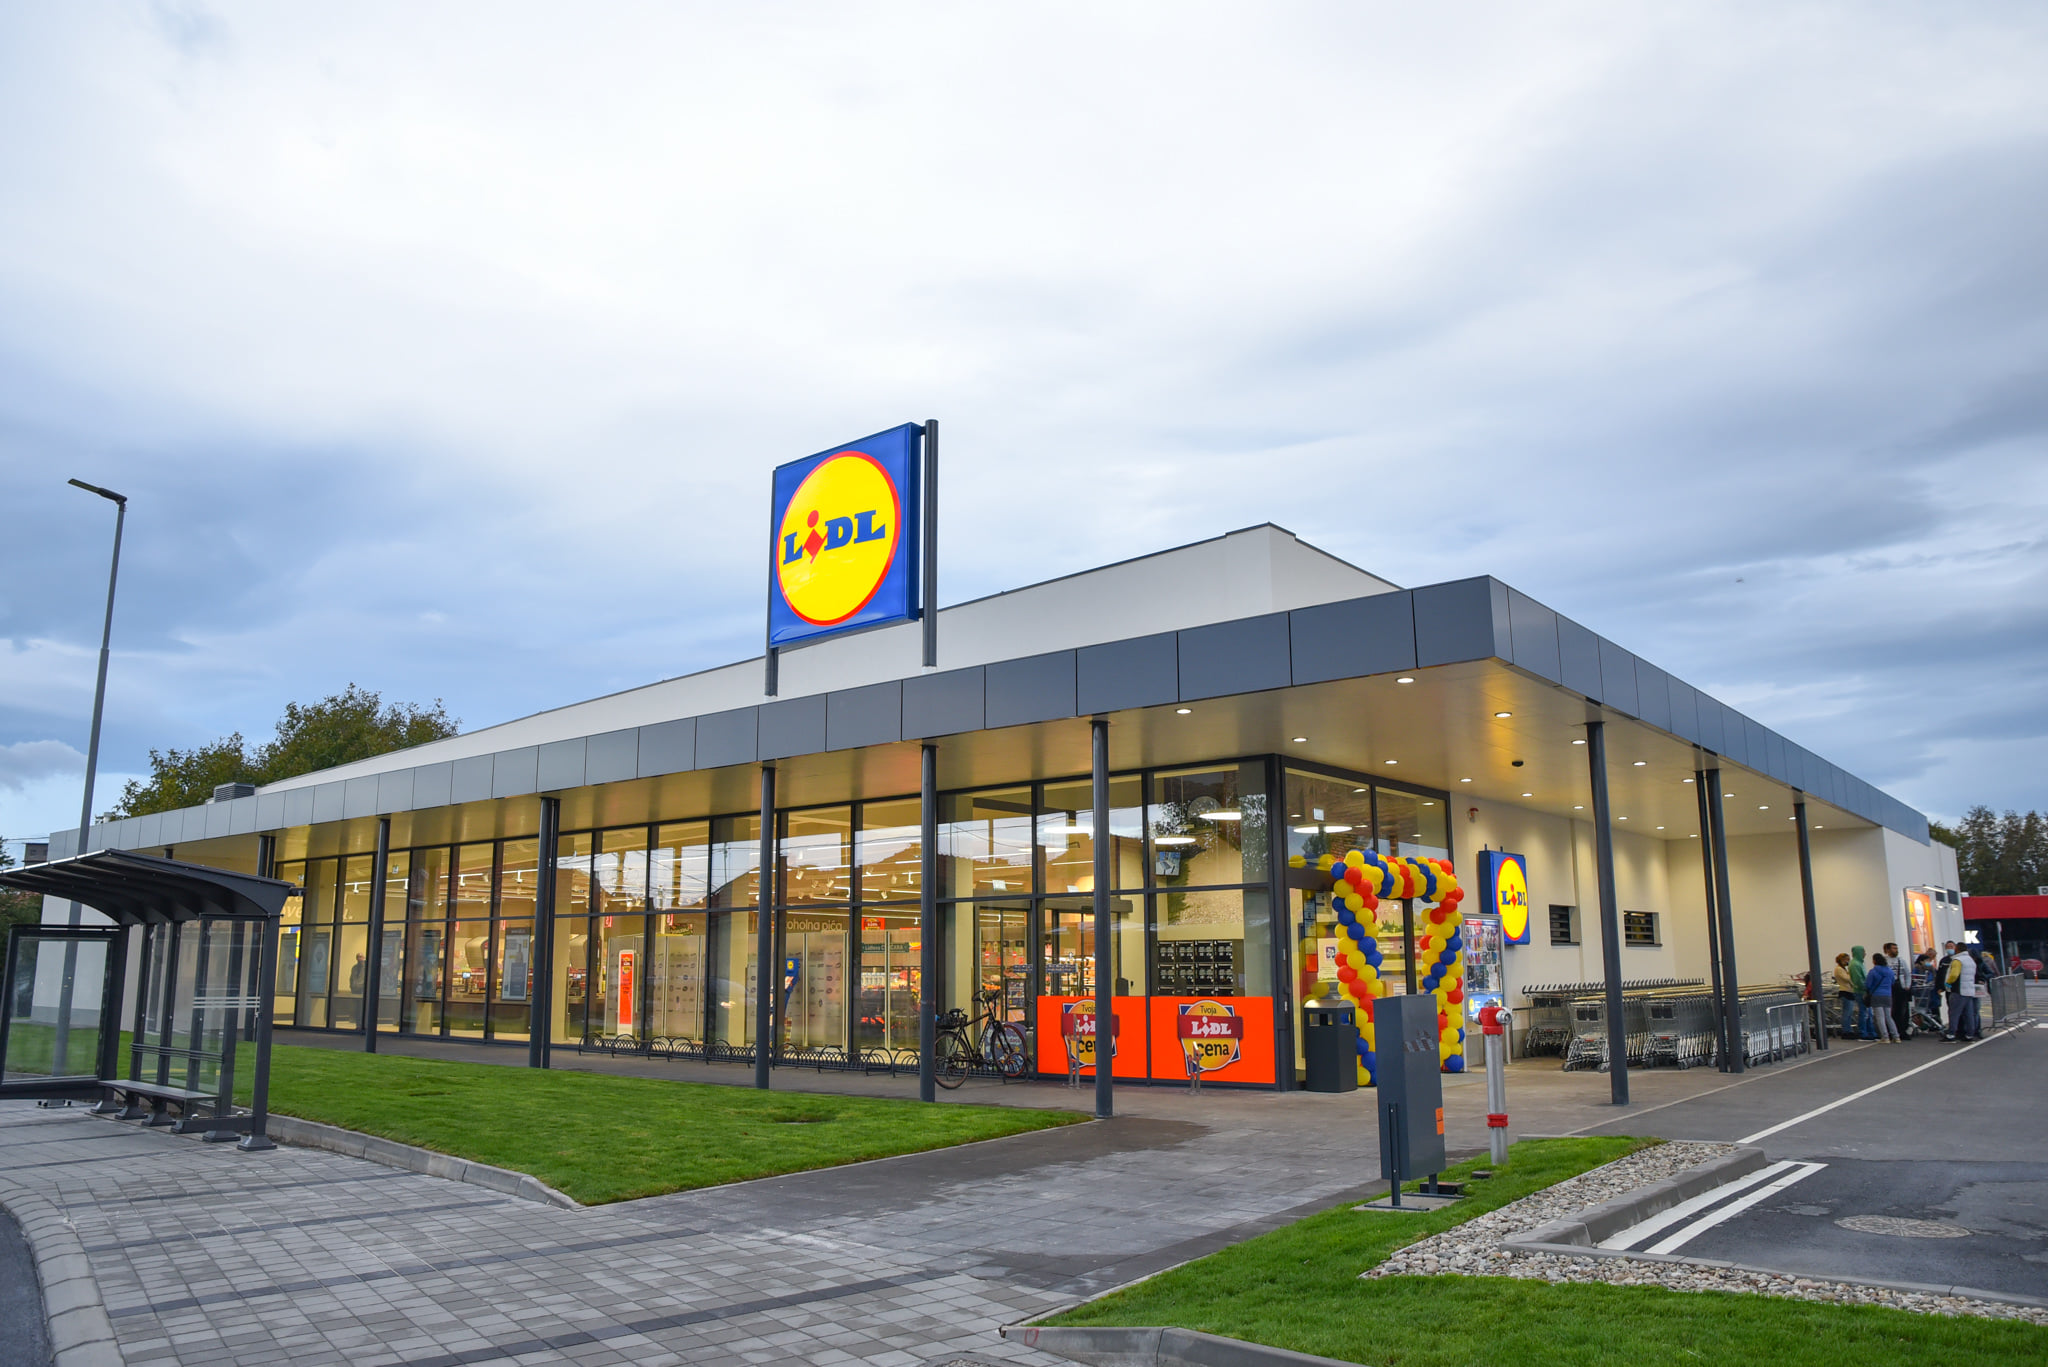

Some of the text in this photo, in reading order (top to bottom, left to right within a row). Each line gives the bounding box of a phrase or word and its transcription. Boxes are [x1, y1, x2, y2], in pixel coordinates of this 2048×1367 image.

[787, 917, 820, 931] oholna
[1964, 930, 1980, 944] K
[1200, 1005, 1217, 1015] Tvoja
[1196, 1042, 1230, 1056] cena
